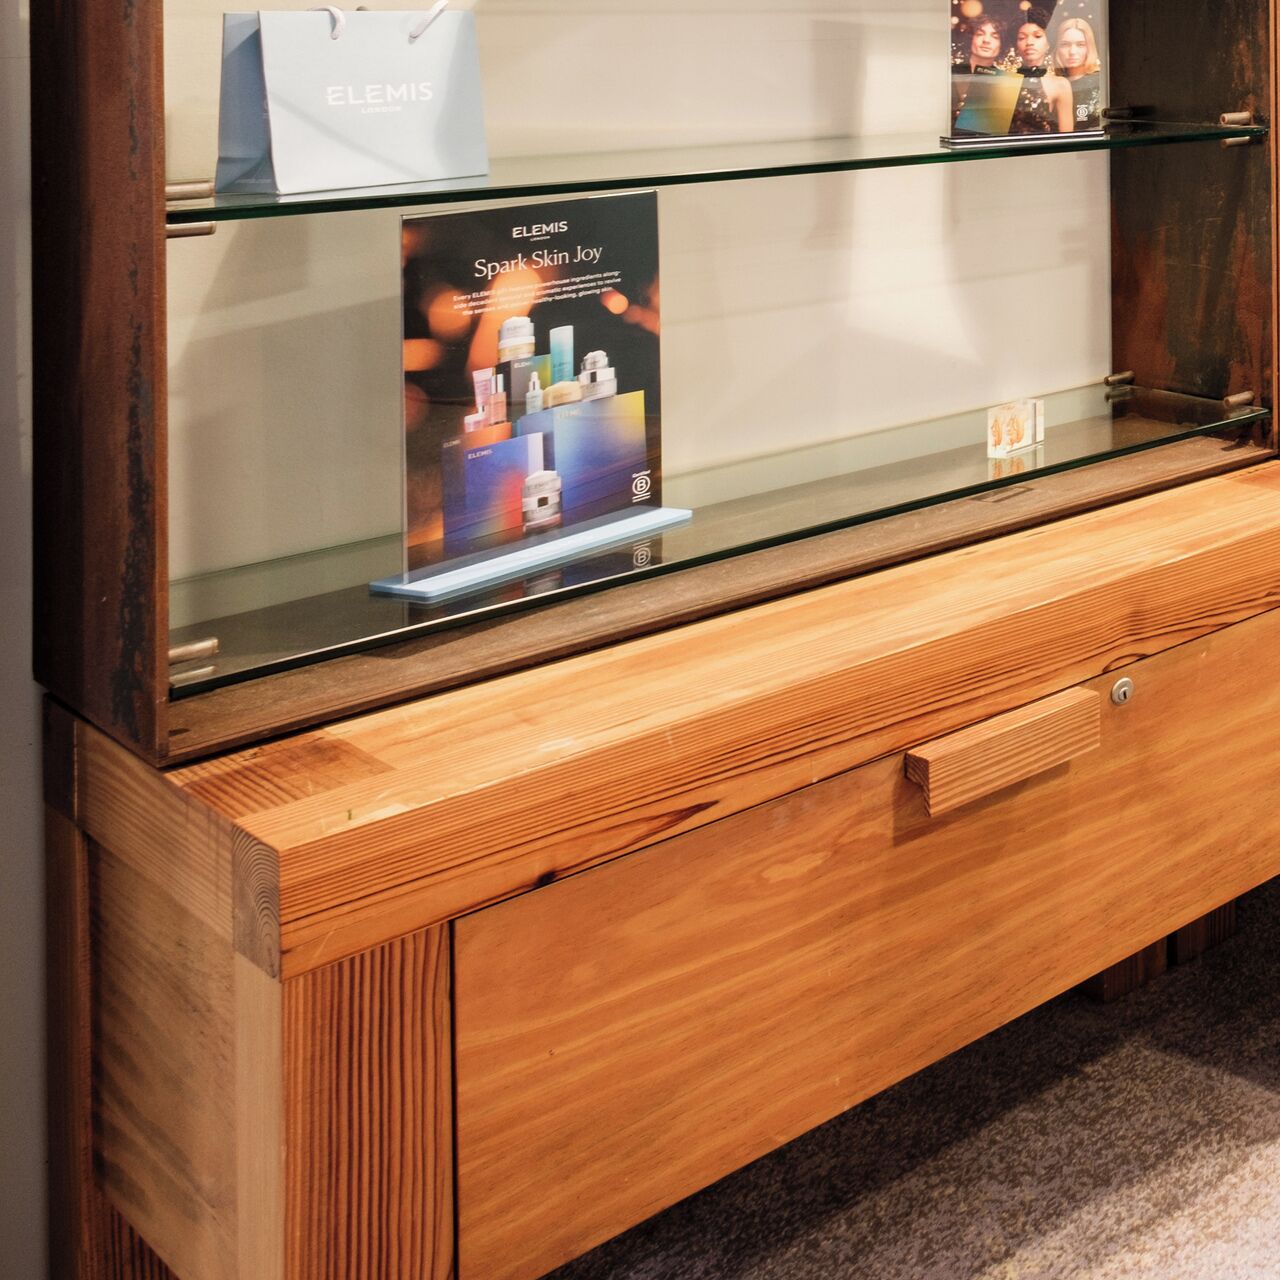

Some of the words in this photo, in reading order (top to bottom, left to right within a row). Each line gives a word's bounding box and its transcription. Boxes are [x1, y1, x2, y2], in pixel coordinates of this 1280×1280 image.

[325, 81, 433, 106] ELEMIS
[512, 221, 568, 238] ELEMIS
[474, 253, 528, 280] Spark
[532, 249, 569, 270] Skin
[573, 245, 603, 264] Joy
